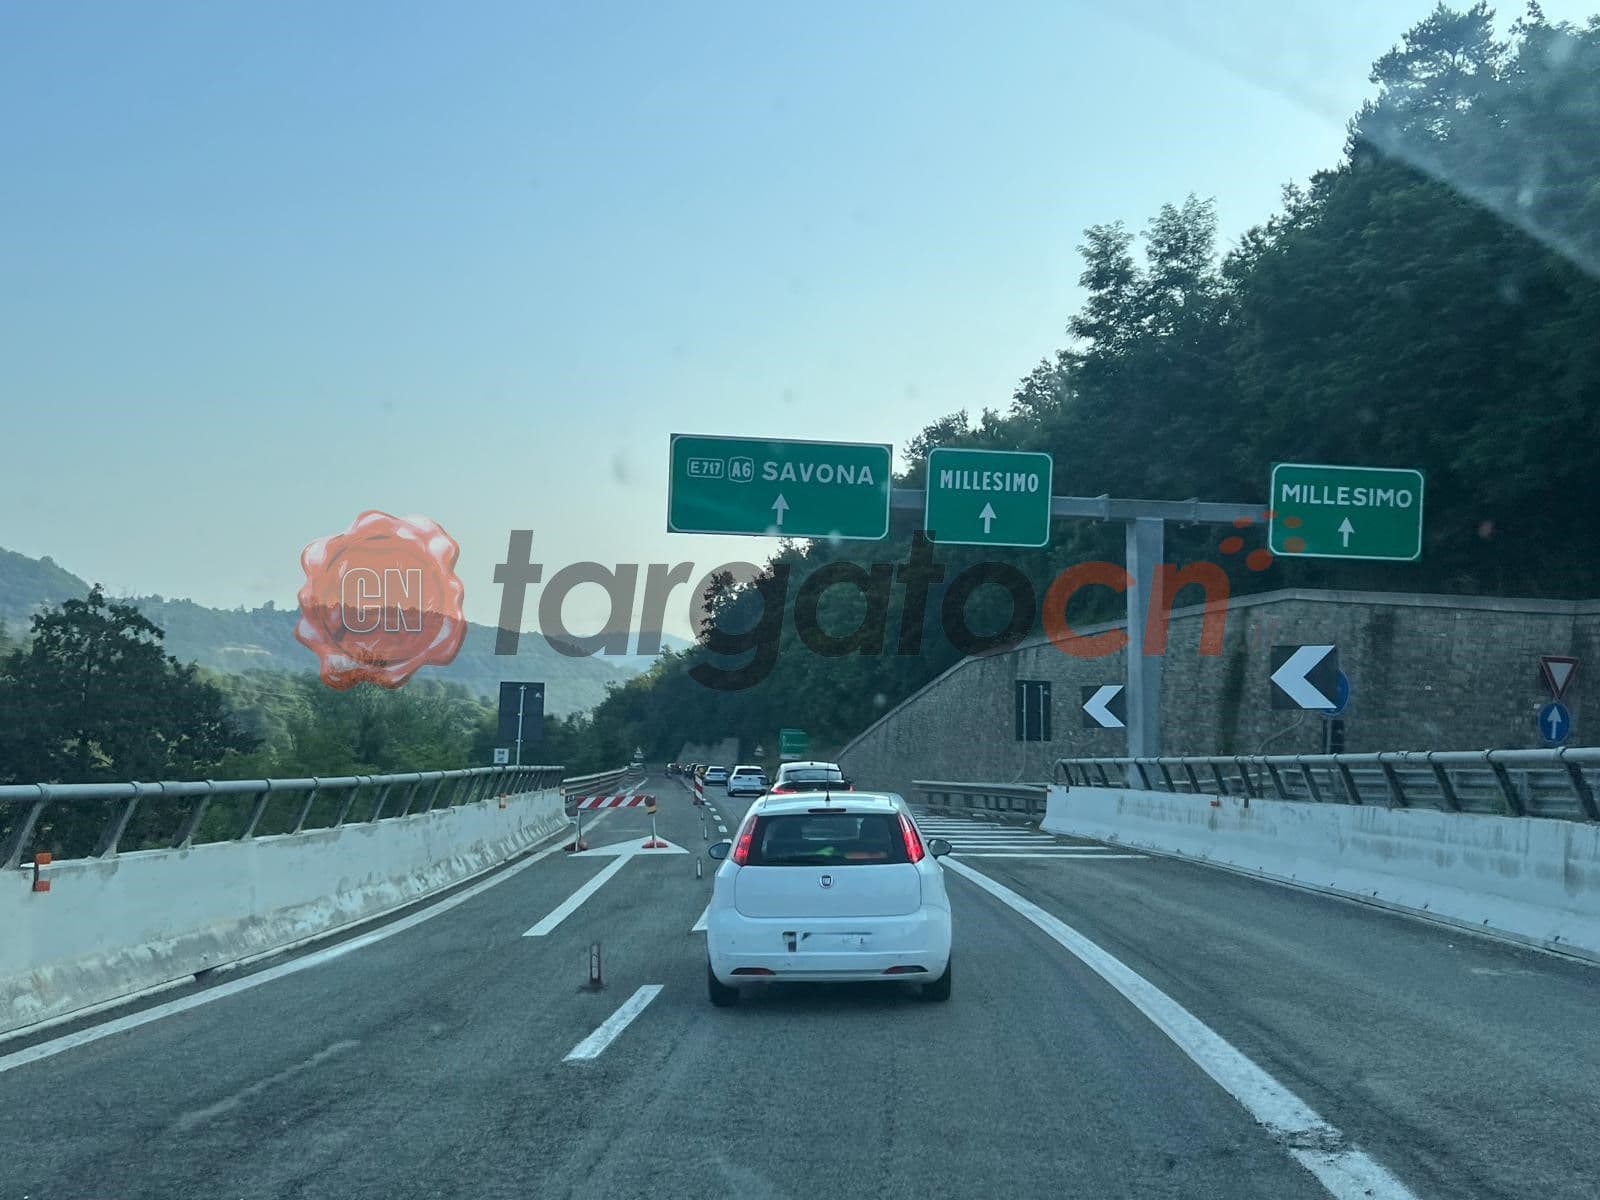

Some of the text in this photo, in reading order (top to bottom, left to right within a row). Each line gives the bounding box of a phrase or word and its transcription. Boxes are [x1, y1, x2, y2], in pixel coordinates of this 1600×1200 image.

[731, 461, 751, 478] A6
[762, 461, 874, 485] SAVONA
[939, 469, 1039, 493] MILLESIMO
[1281, 484, 1413, 508] MILLESIMO
